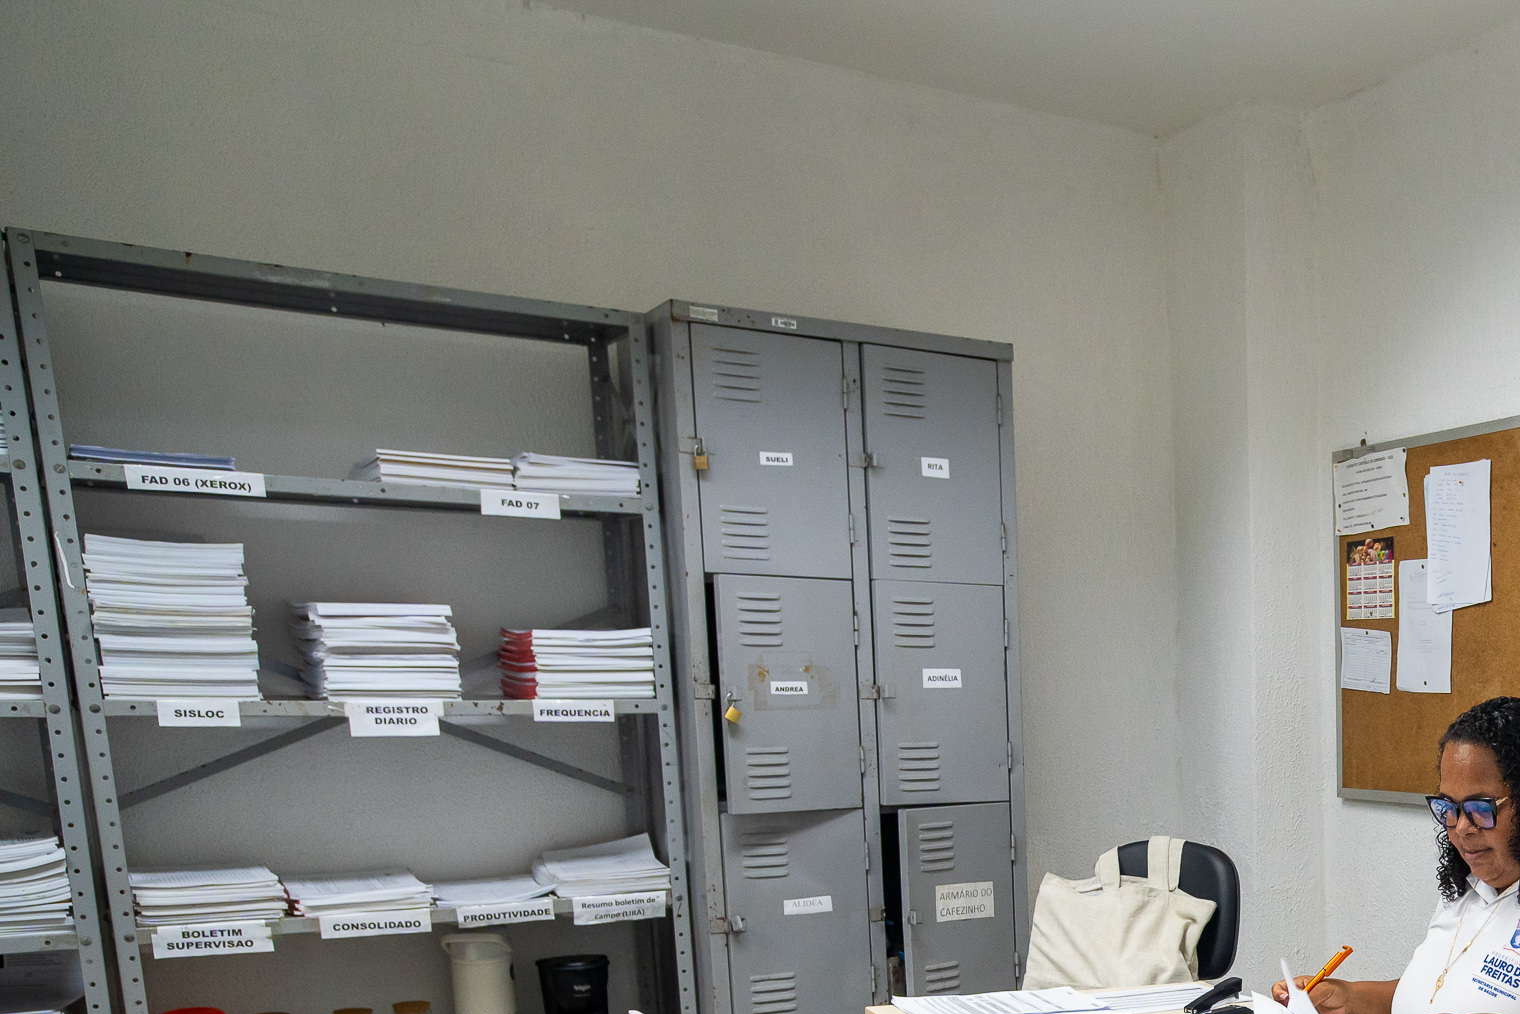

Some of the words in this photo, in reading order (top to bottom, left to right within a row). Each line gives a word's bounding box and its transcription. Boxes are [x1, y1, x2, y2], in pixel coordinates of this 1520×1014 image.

[927, 463, 943, 471] RITA
[141, 475, 168, 485] FAD
[173, 477, 190, 487] 06
[195, 478, 252, 493] (XEROX)
[501, 499, 523, 508] FAD
[526, 501, 540, 510] 07
[927, 673, 958, 682] ADINÉLIA
[174, 709, 225, 719] SISLOC
[366, 705, 429, 715] REGISTRO
[539, 709, 611, 717] FREQUENCIA
[374, 717, 418, 726] DIARIO
[940, 888, 979, 901] ARMÁRIO
[980, 887, 993, 897] DO
[581, 900, 613, 909] Resumo
[614, 898, 645, 907] boletim
[646, 896, 656, 904] de
[463, 907, 551, 923] PRODUTIVIDADE
[940, 903, 986, 917] CAFEZINHO
[594, 912, 620, 920] campo
[332, 919, 422, 932] CONSOLIDADO
[181, 928, 243, 939] BOLETIM
[166, 939, 254, 951] SUPERVISAO
[1483, 954, 1514, 973] LAURO
[1480, 964, 1520, 989] FREITAS
